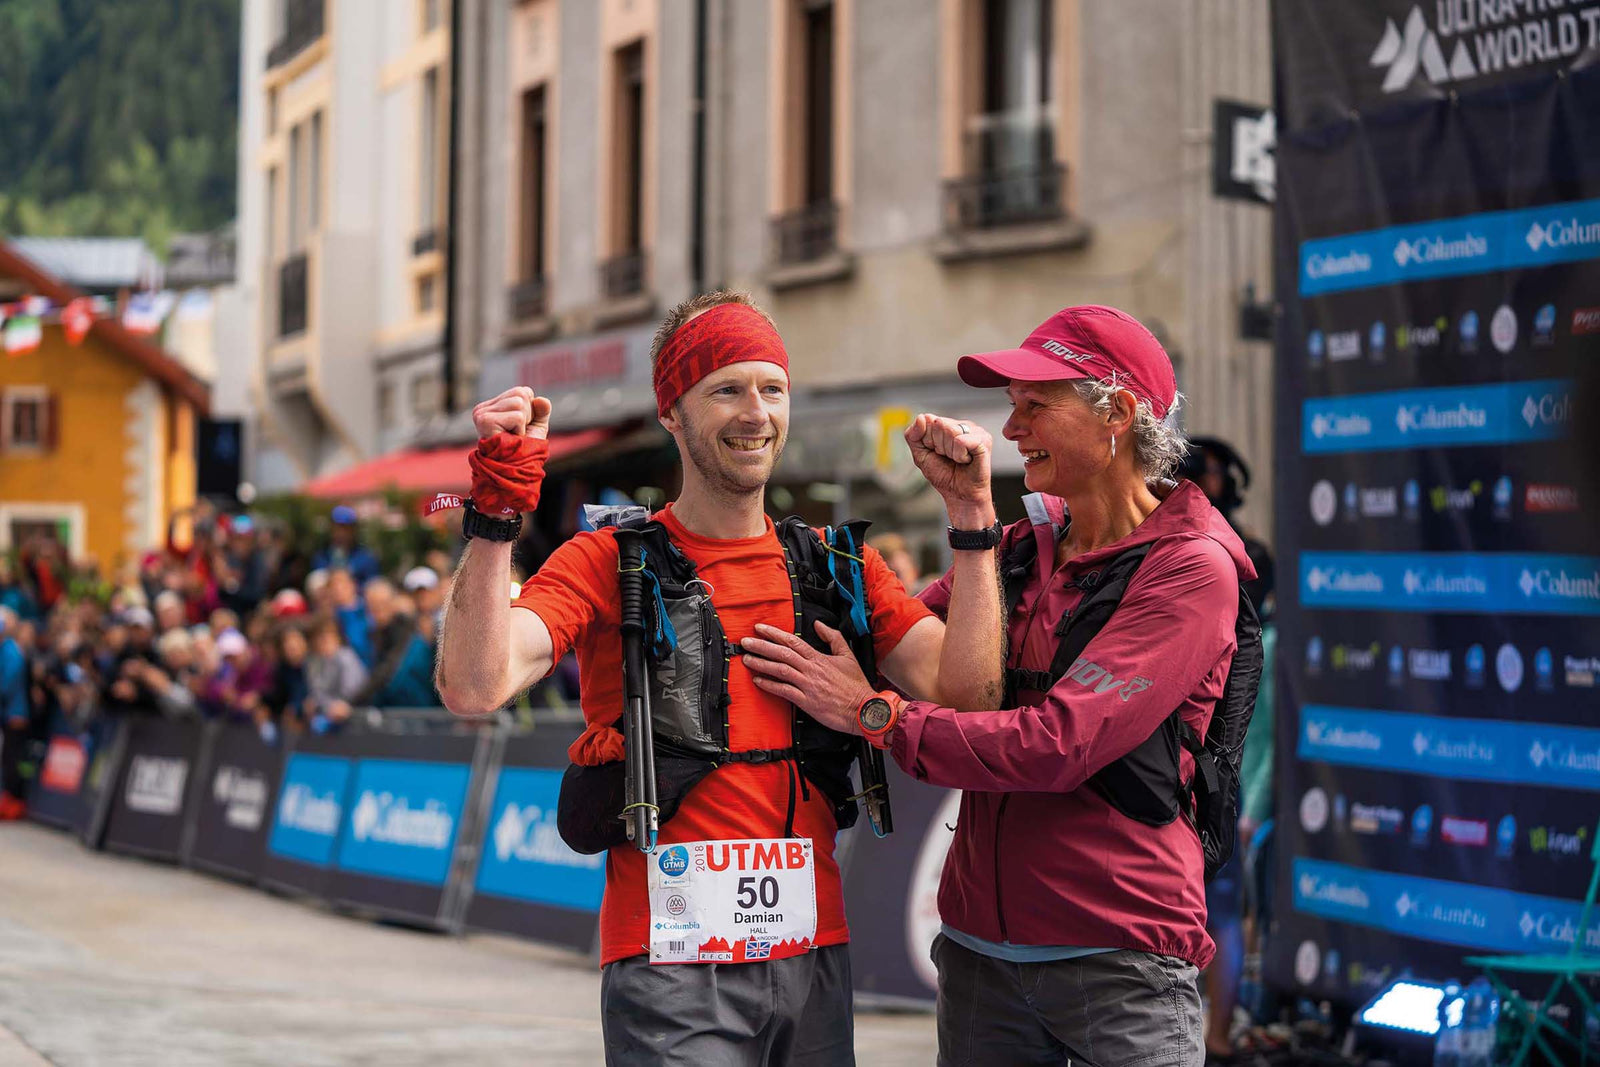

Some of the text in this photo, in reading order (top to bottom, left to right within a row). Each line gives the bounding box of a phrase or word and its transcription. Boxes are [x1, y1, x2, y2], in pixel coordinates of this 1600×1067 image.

[1475, 7, 1600, 73] WORLD T
[430, 497, 461, 512] UTMB
[663, 861, 686, 869] UTMB
[694, 845, 705, 873] 2018
[706, 842, 807, 872] UTMB
[736, 875, 780, 909] 50
[663, 921, 700, 930] Columbia
[734, 912, 784, 924] Damian
